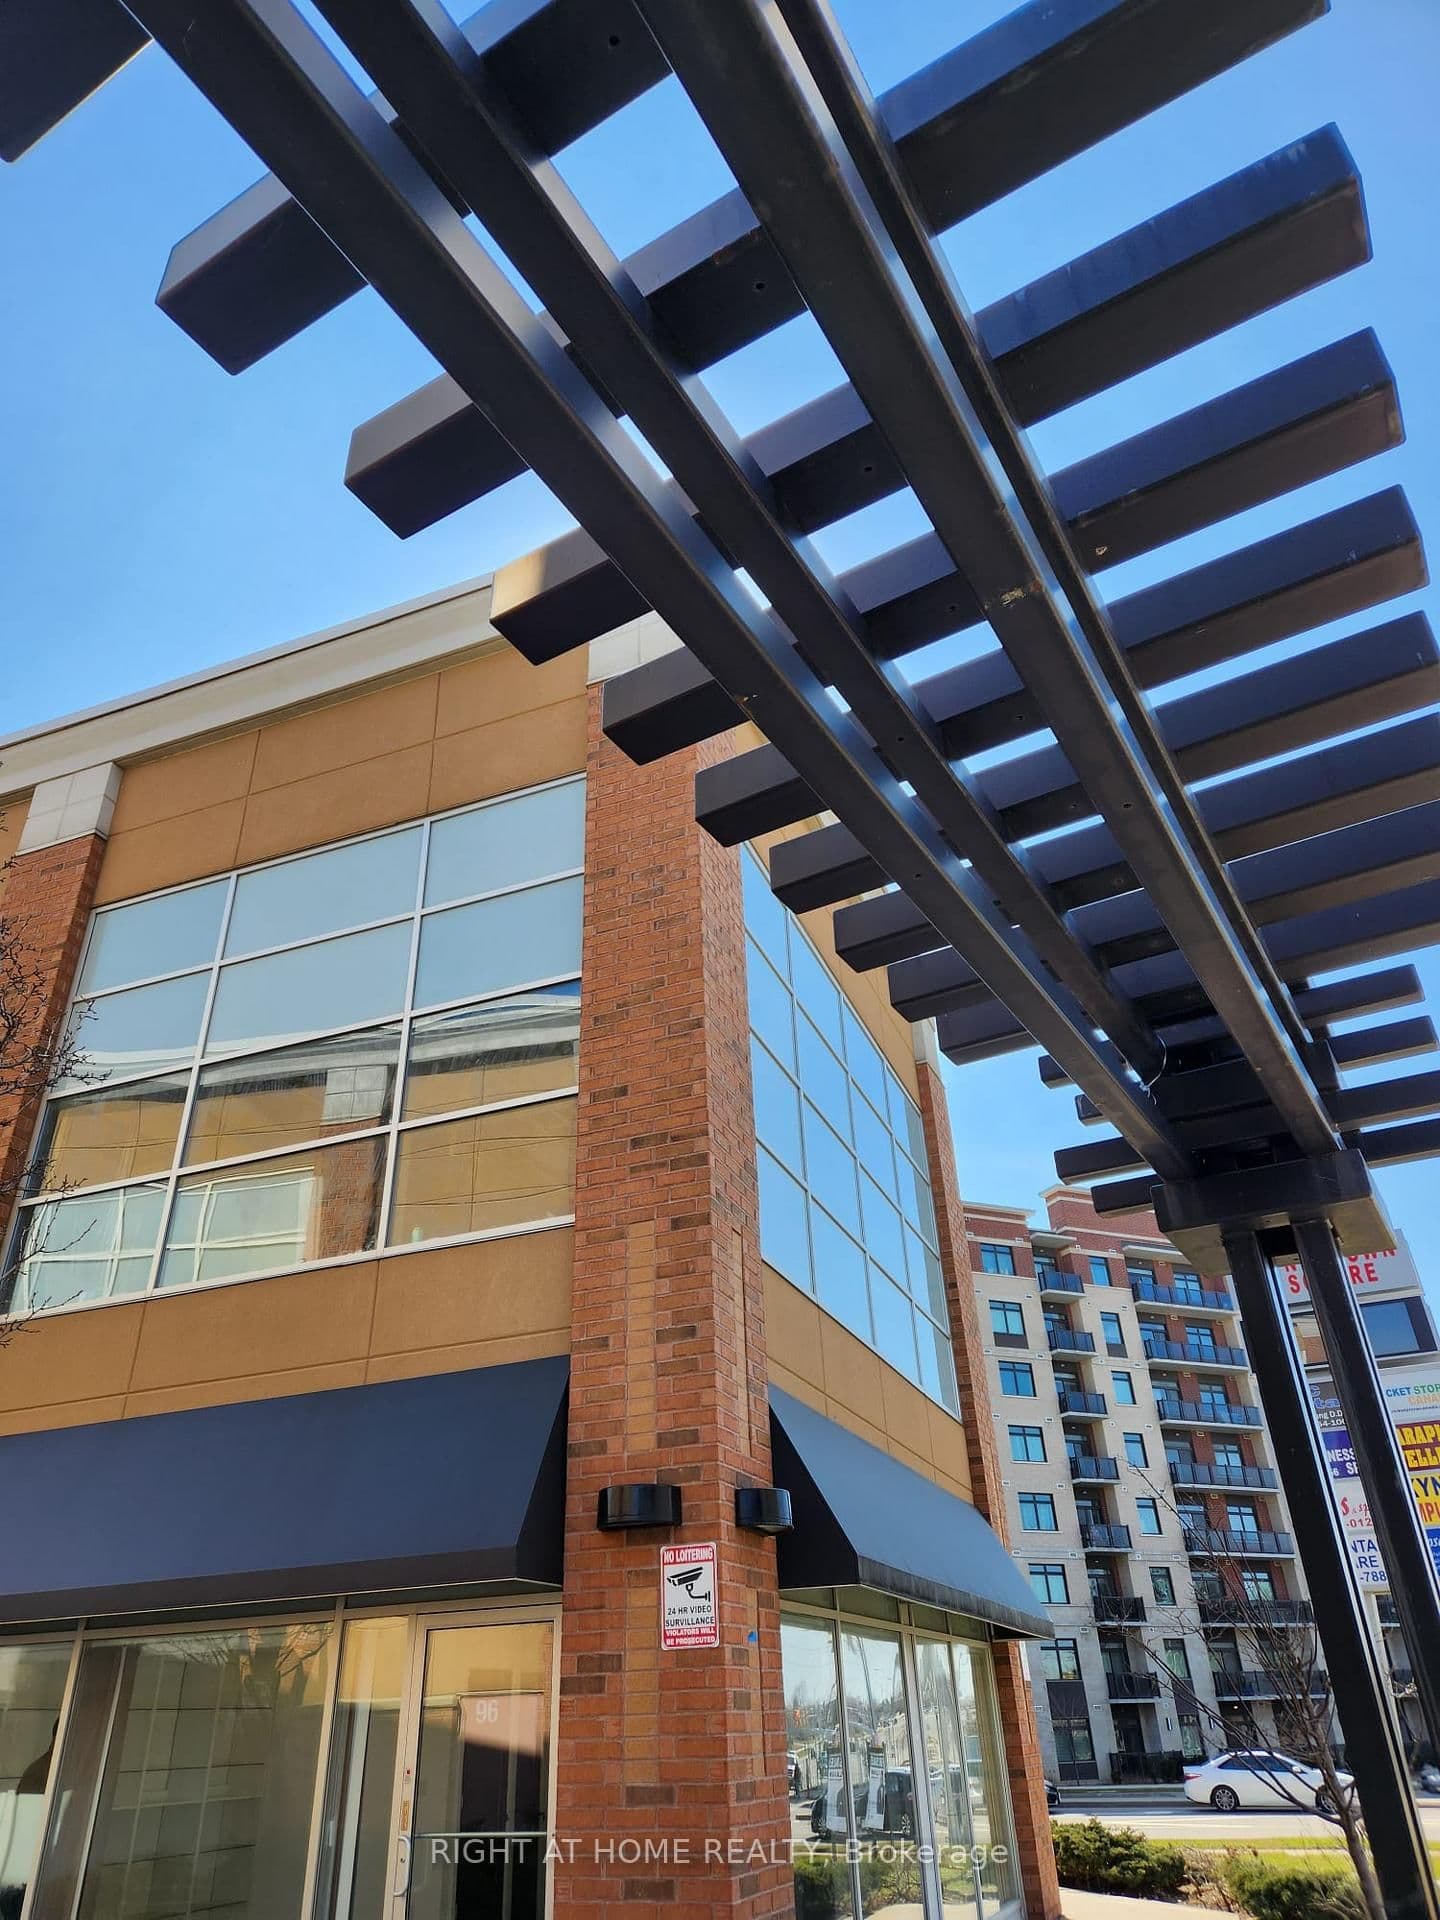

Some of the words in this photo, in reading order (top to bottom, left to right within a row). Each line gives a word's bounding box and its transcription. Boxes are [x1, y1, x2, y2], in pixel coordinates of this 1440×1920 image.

[663, 1550, 674, 1564] NO
[675, 1547, 713, 1562] LOITERING
[1356, 1555, 1379, 1569] RE
[667, 1607, 676, 1616] 24
[678, 1606, 688, 1615] HR
[690, 1604, 712, 1614] VIDEO
[665, 1628, 699, 1637] VIOLATORS
[700, 1627, 716, 1635] WILL
